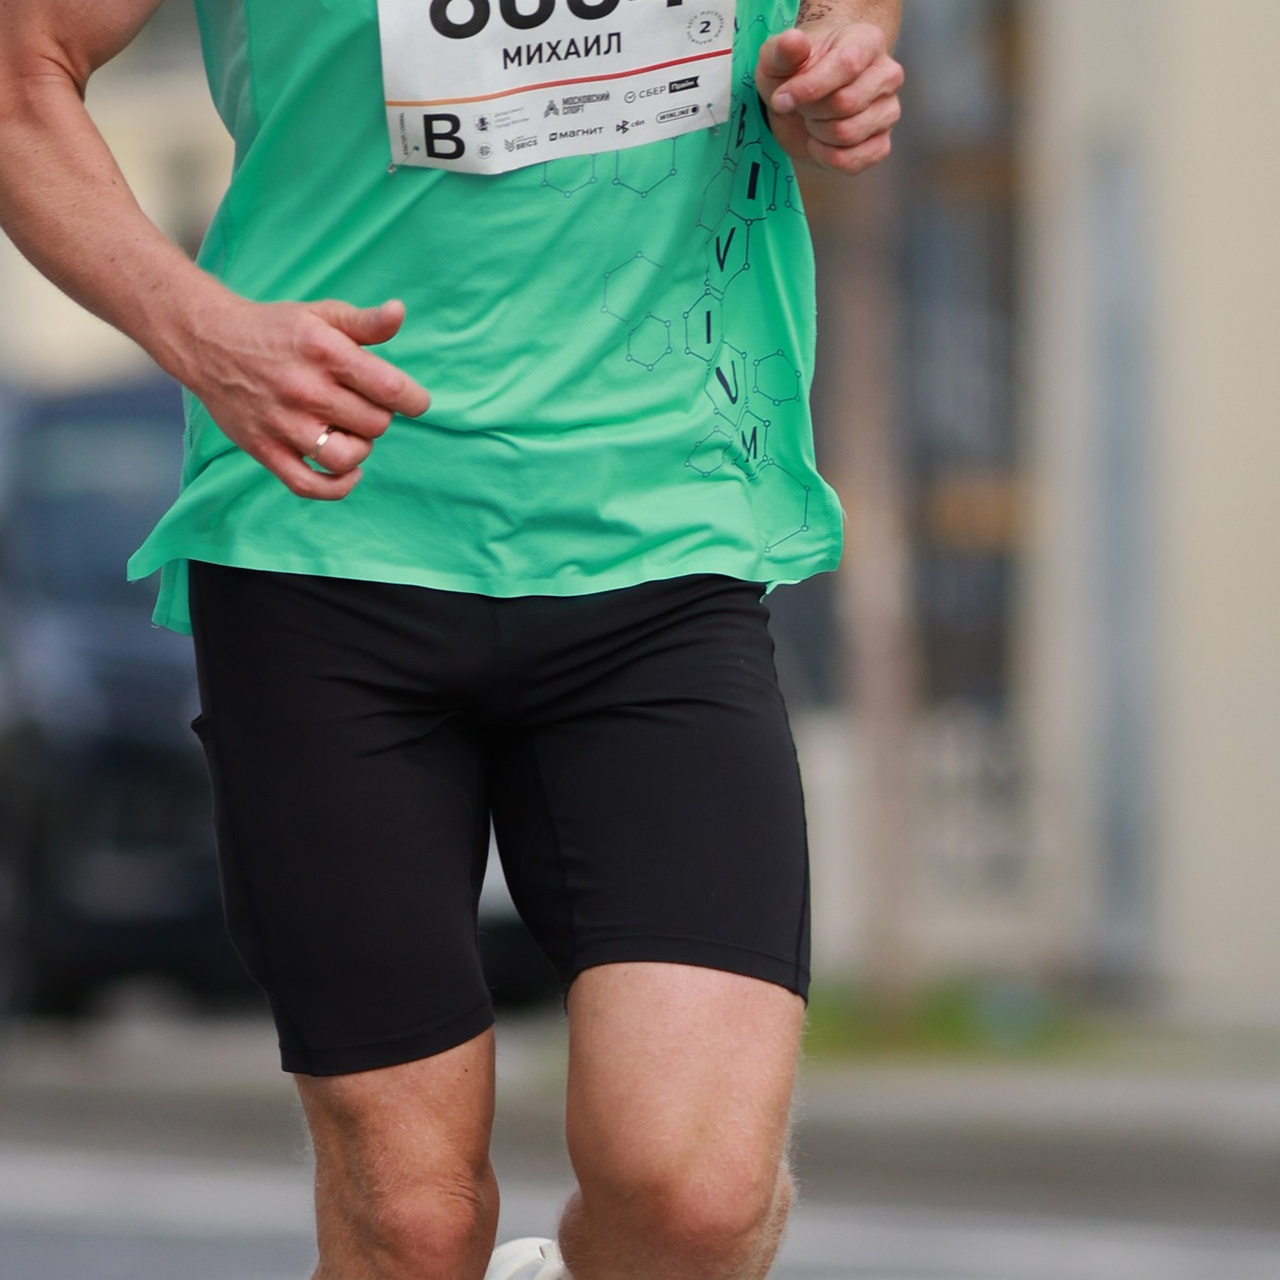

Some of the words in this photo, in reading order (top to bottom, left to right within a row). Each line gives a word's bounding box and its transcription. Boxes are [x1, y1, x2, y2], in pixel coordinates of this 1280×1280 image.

[700, 20, 710, 34] 2
[502, 31, 622, 70] МИХАИЛ
[562, 90, 610, 106] МОСКОВСКИЙ
[639, 85, 667, 99] СБЕР
[562, 104, 585, 115] СПОРТ
[659, 109, 691, 121] WINLINE
[559, 126, 604, 140] магнит
